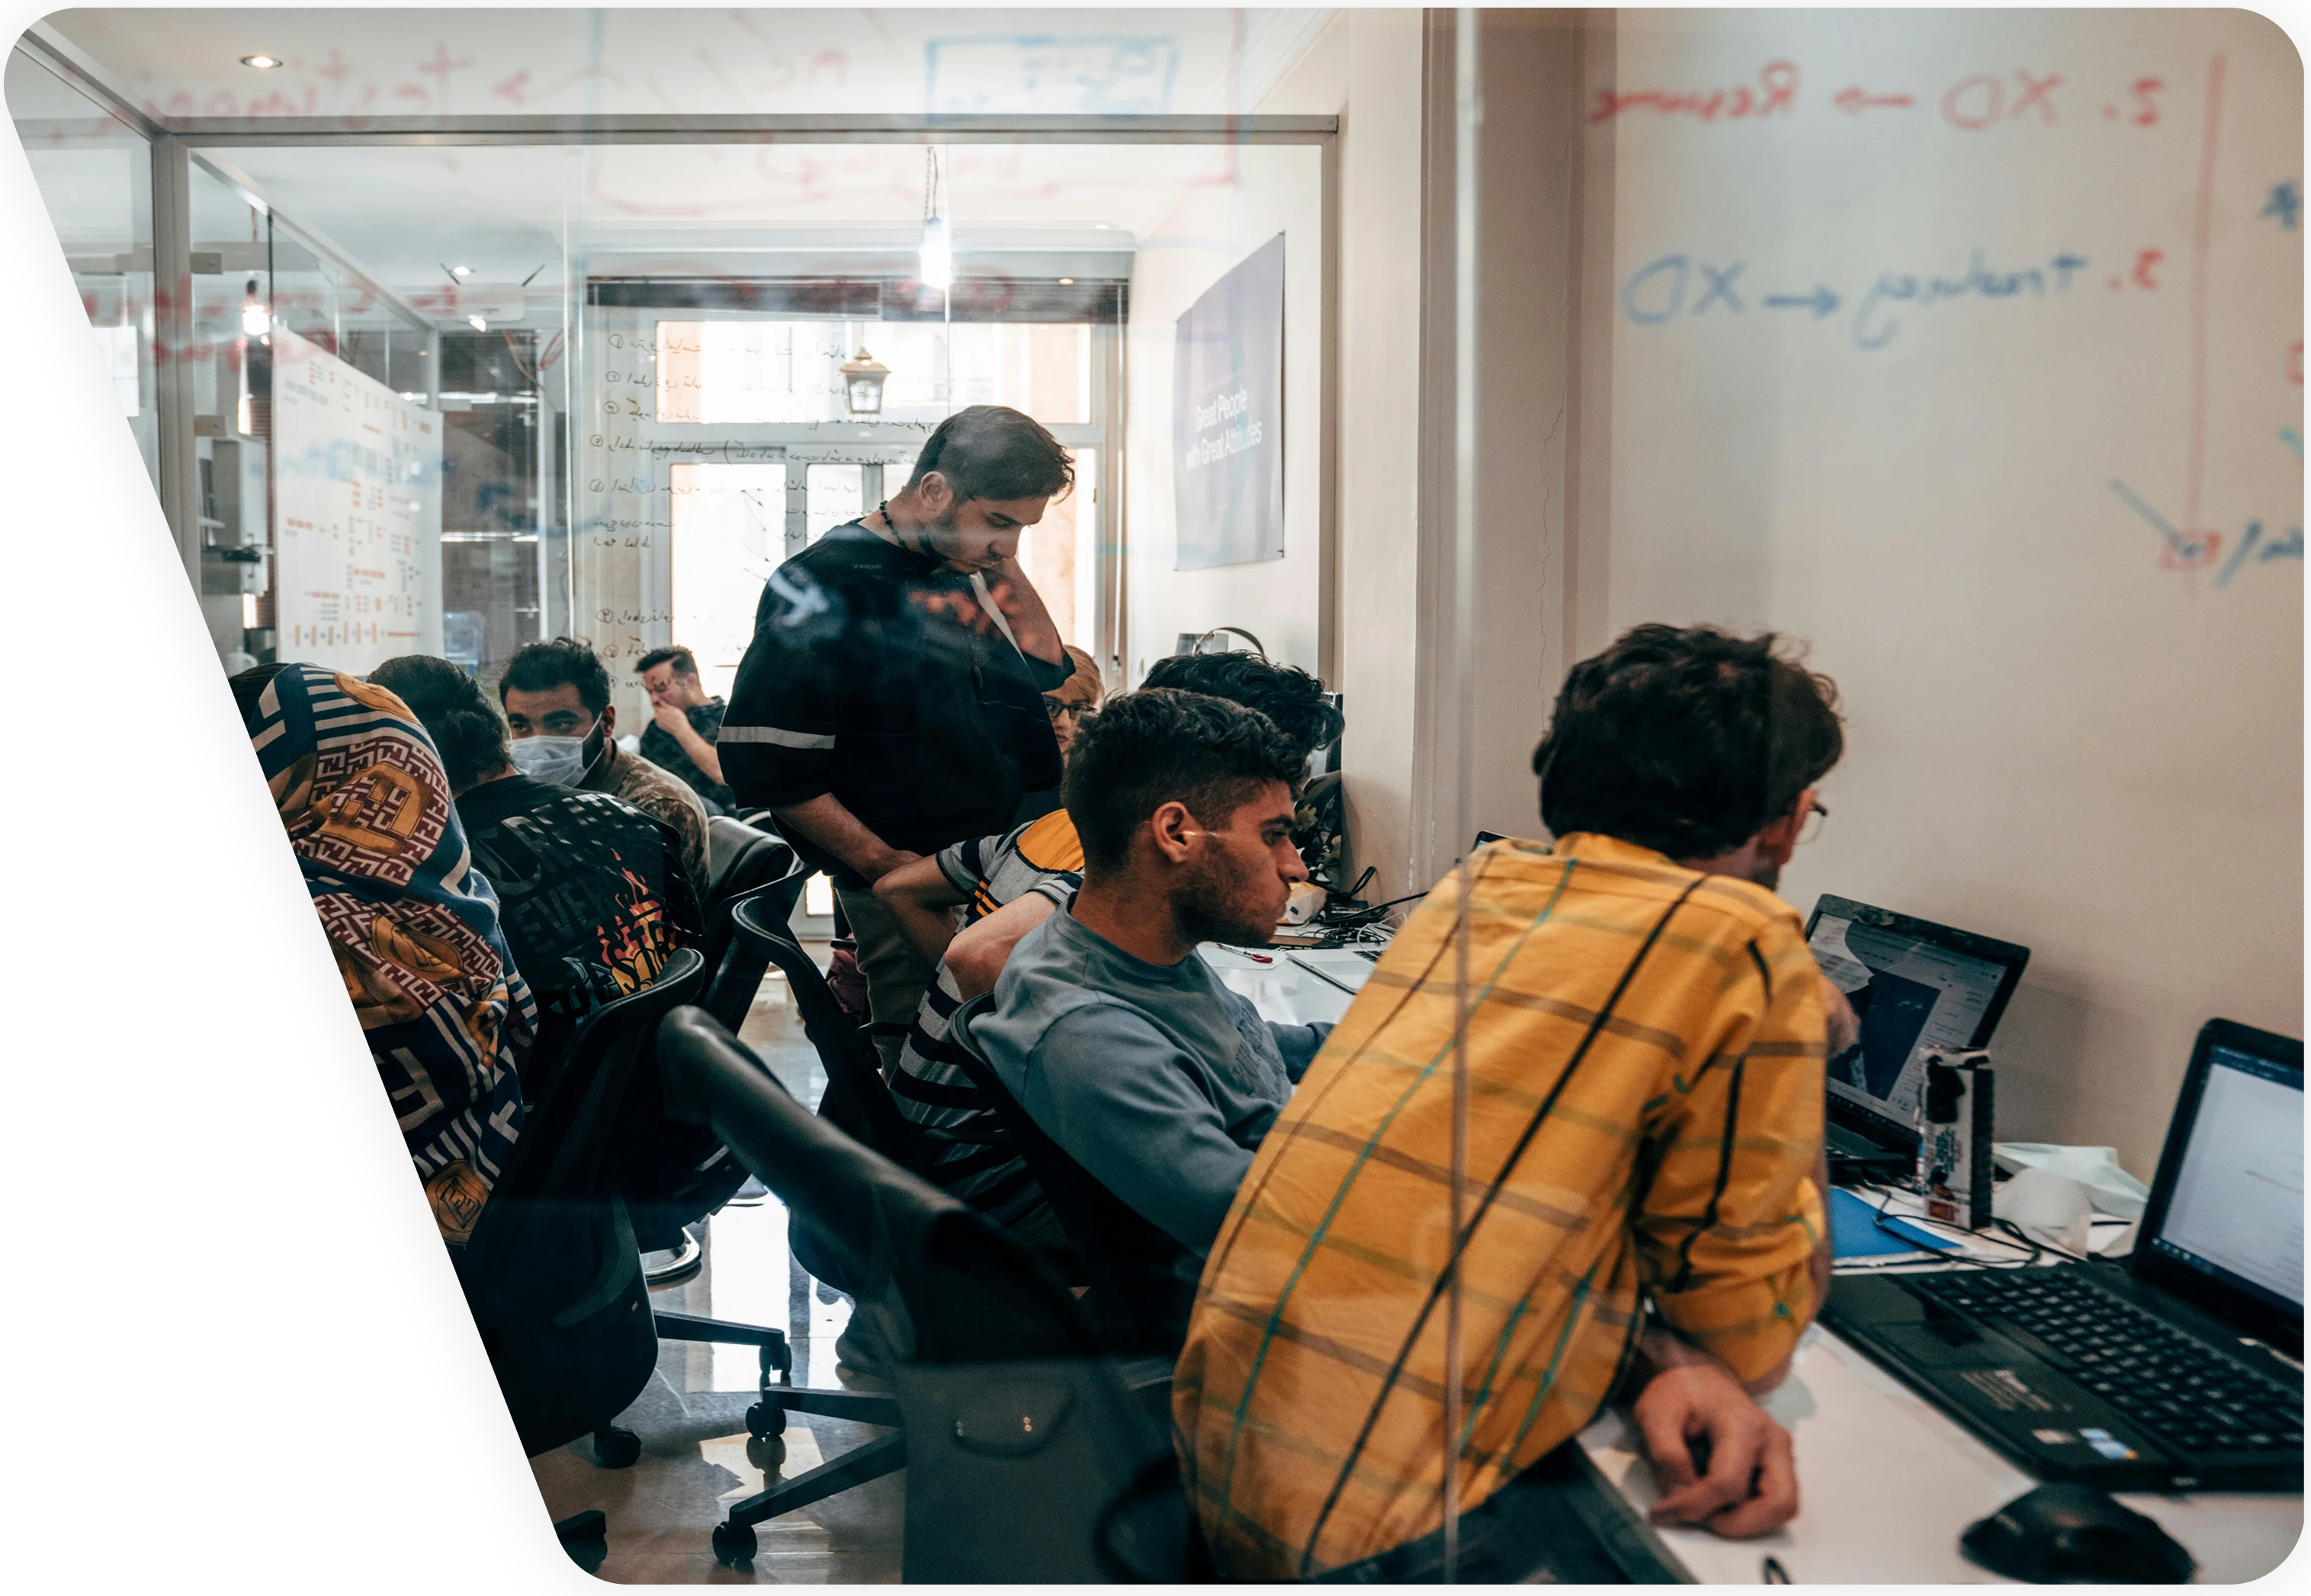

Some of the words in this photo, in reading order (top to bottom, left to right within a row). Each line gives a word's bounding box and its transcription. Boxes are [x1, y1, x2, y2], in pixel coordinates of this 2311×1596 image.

[1196, 400, 1218, 432] Great
[1218, 384, 1247, 422] People
[1201, 432, 1225, 466] Great
